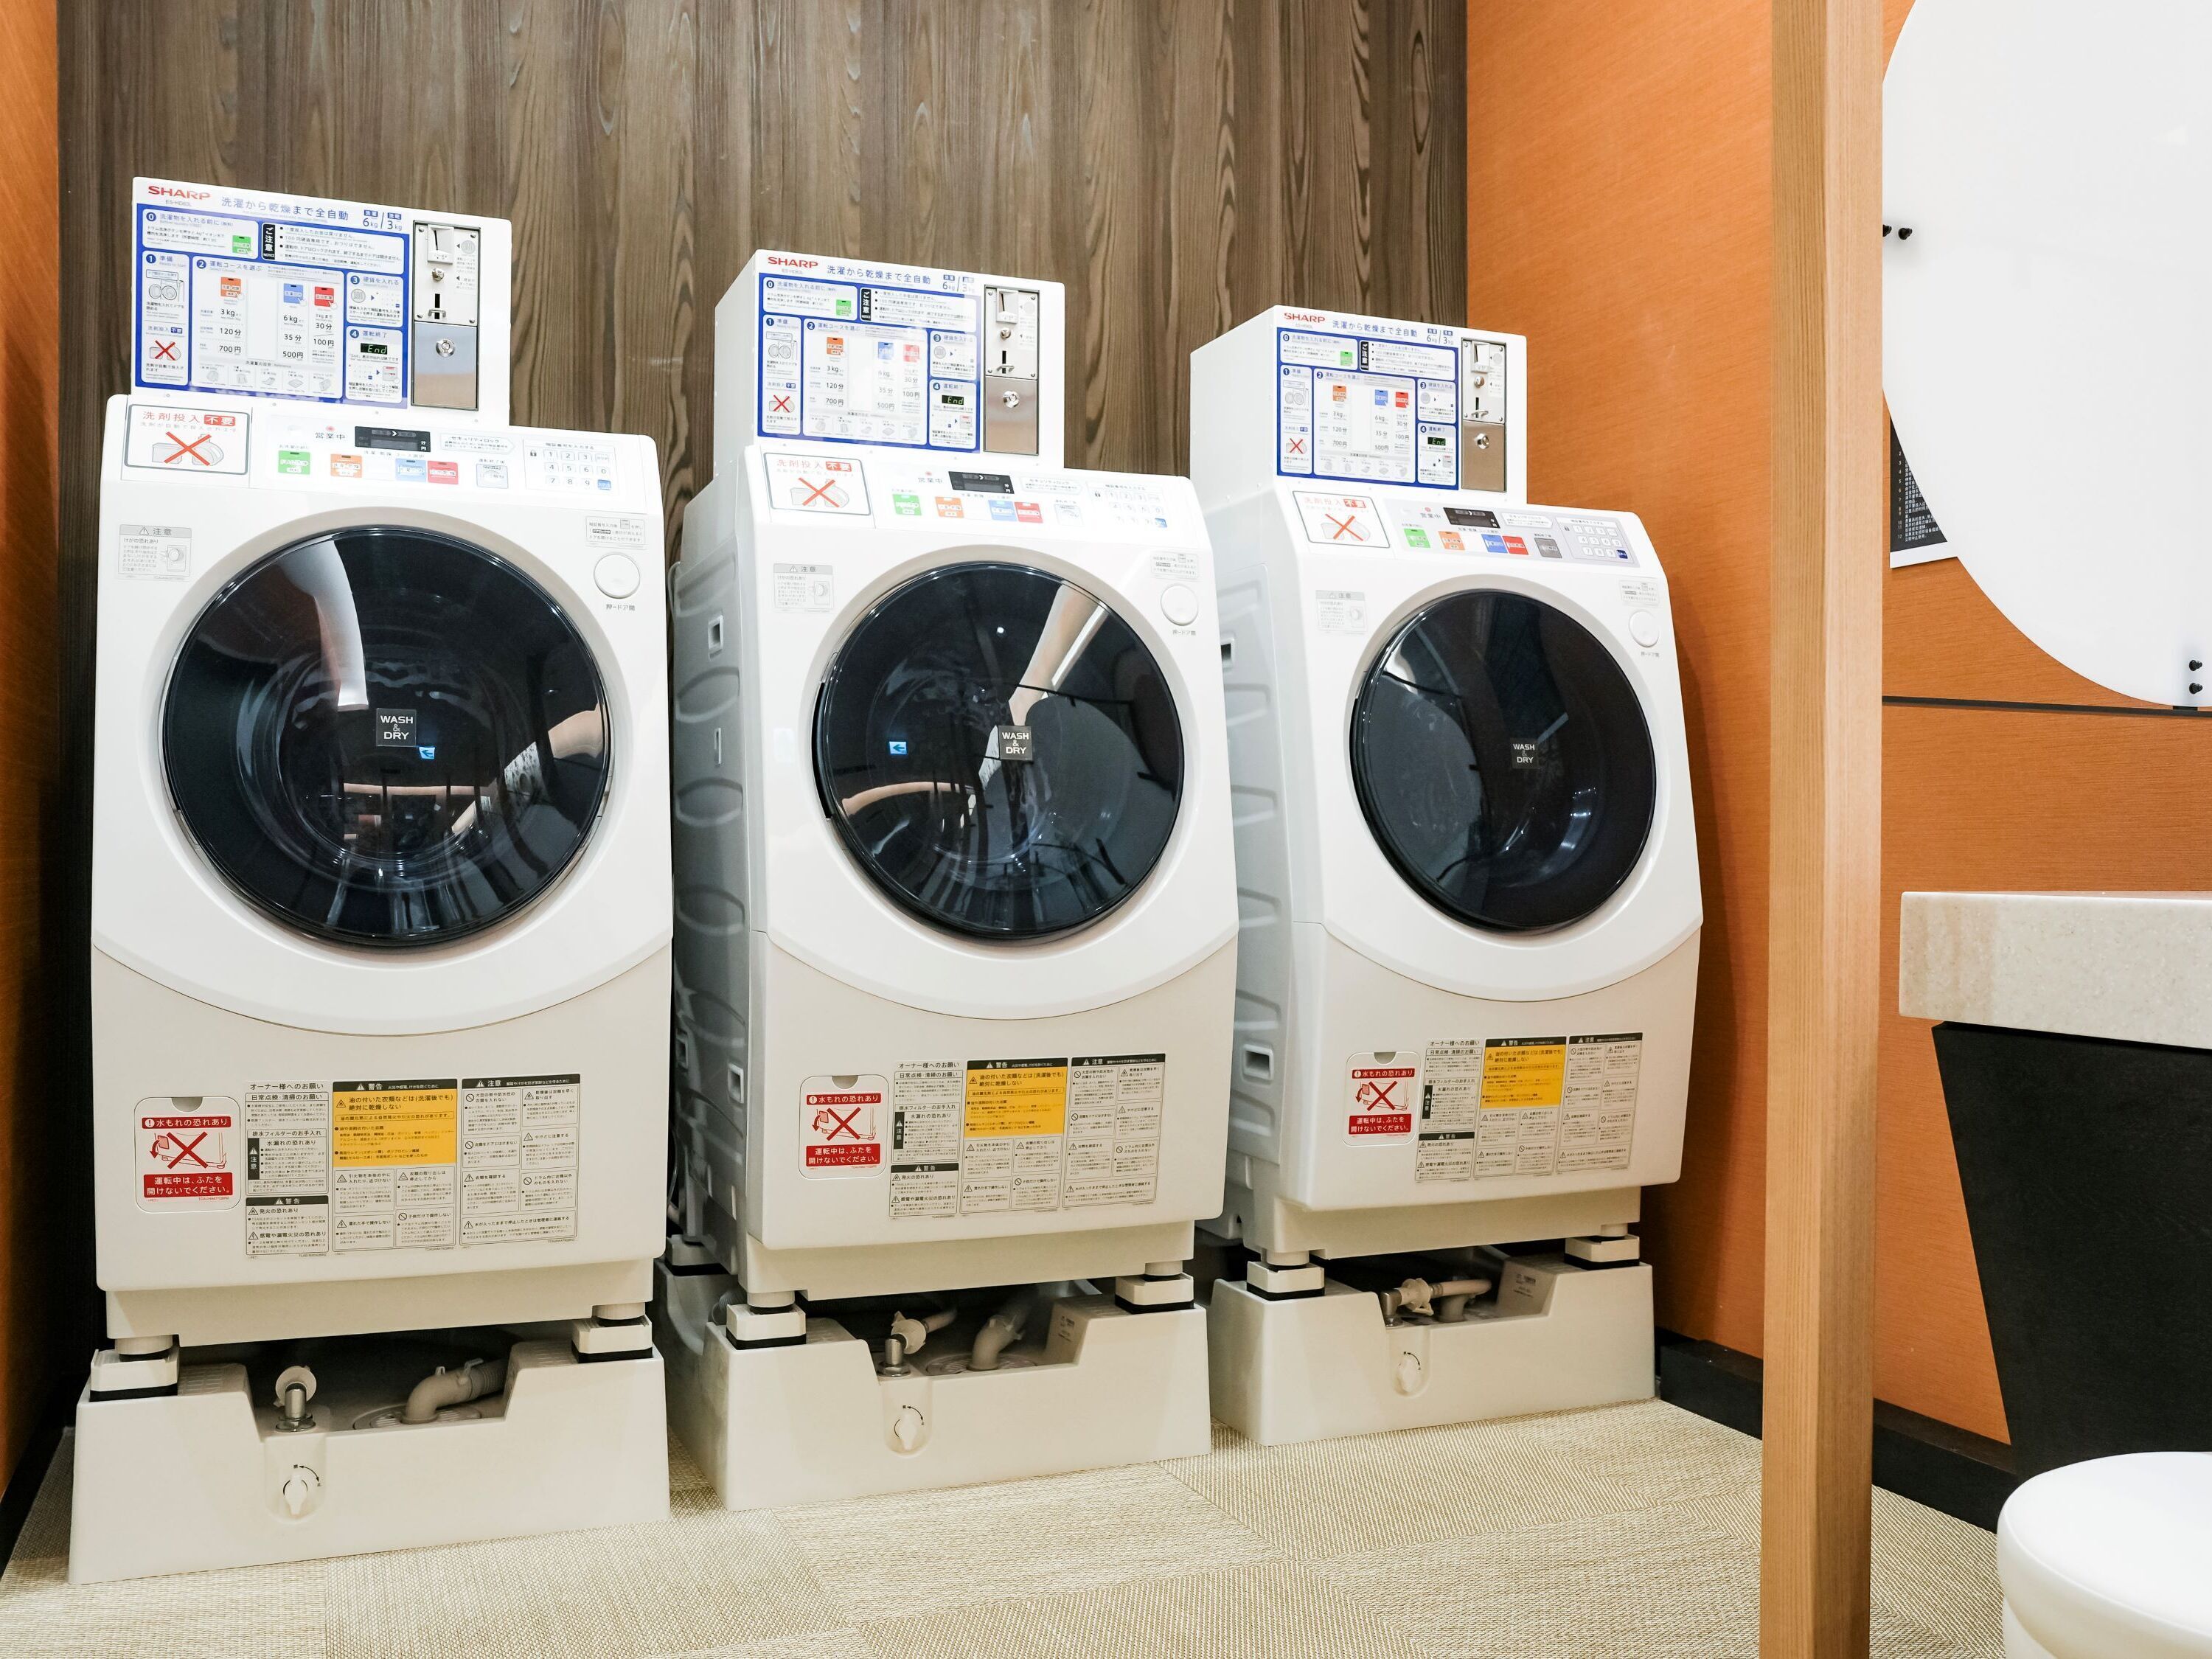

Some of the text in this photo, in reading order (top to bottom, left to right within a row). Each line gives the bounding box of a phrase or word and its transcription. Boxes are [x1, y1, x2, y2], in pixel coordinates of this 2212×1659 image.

[148, 186, 210, 200] SHARP
[221, 195, 349, 220] 洗濯から乾燥まで全自動
[209, 260, 261, 271] 運転コースを選ぶ
[768, 257, 818, 268] SHARP
[827, 265, 931, 285] 洗濯から乾燥まで全自動
[363, 276, 399, 286] 硬貨を入れる
[1284, 312, 1326, 323] SHARP
[1332, 319, 1418, 338] 洗濯から乾燥まで全自動
[362, 330, 387, 338] 運転終了
[367, 344, 387, 354] End
[947, 396, 964, 405] End
[143, 411, 200, 423] 洗剤投入
[206, 416, 233, 426] 不要
[153, 527, 171, 535] 注意
[380, 715, 413, 724] WASH
[392, 723, 400, 732] &
[383, 731, 409, 740] DRY
[818, 1095, 878, 1103] 水もれの恐れあり
[156, 1119, 227, 1127] 水もれの恐れあり
[815, 1147, 872, 1155] 運転中は、ふたを
[808, 1156, 877, 1164] 開けないでください。
[154, 1176, 223, 1185] 運転中は、ふたを
[147, 1186, 229, 1194] 開けないでください。
